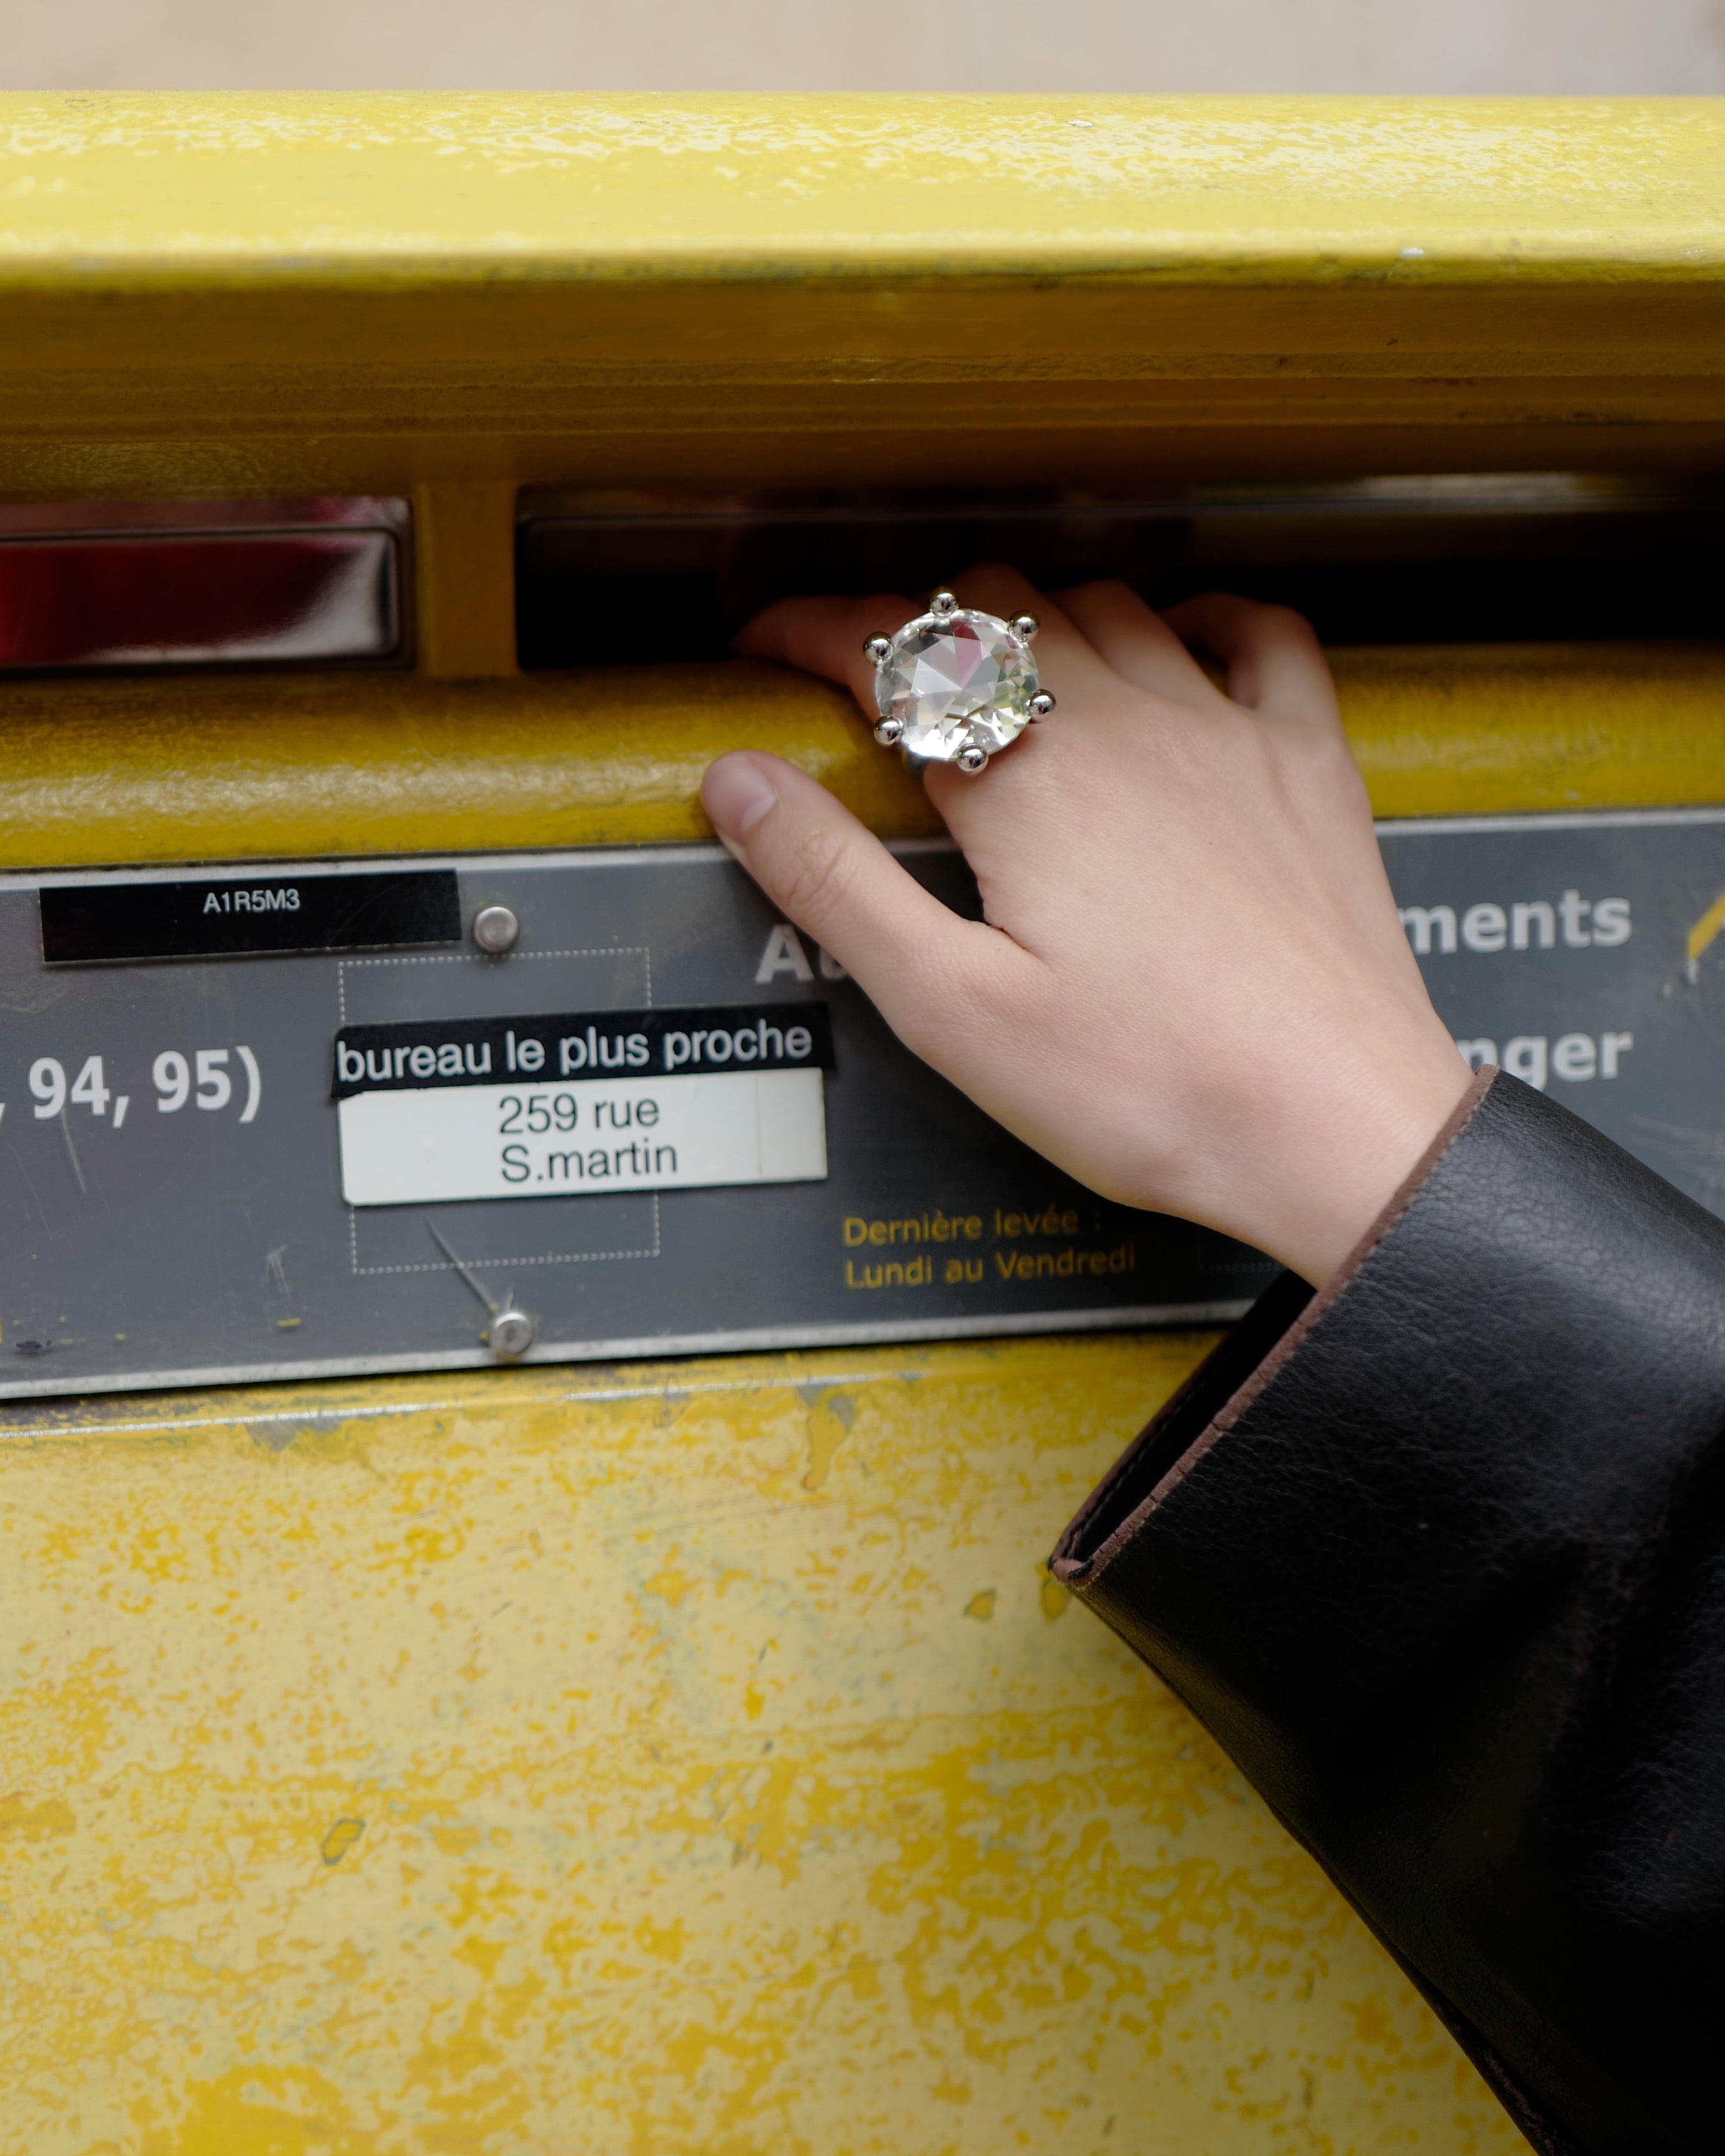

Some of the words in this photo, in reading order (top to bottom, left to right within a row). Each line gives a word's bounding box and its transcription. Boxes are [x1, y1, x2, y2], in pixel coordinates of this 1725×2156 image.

[203, 888, 300, 914] A1R5M3
[337, 1041, 491, 1082] bureau
[507, 1031, 545, 1072] le
[560, 1025, 651, 1074] plus
[664, 1019, 812, 1070] proche
[29, 1055, 129, 1128] 94,
[152, 1045, 261, 1122] 95)
[498, 1093, 578, 1134] 259
[594, 1096, 660, 1129] rue
[502, 1139, 677, 1183] S.martin
[843, 1209, 982, 1246] Dernière
[994, 1205, 1079, 1238] levée
[845, 1255, 933, 1289] Lundi
[945, 1259, 984, 1283] au
[995, 1242, 1136, 1280] Vendredi
